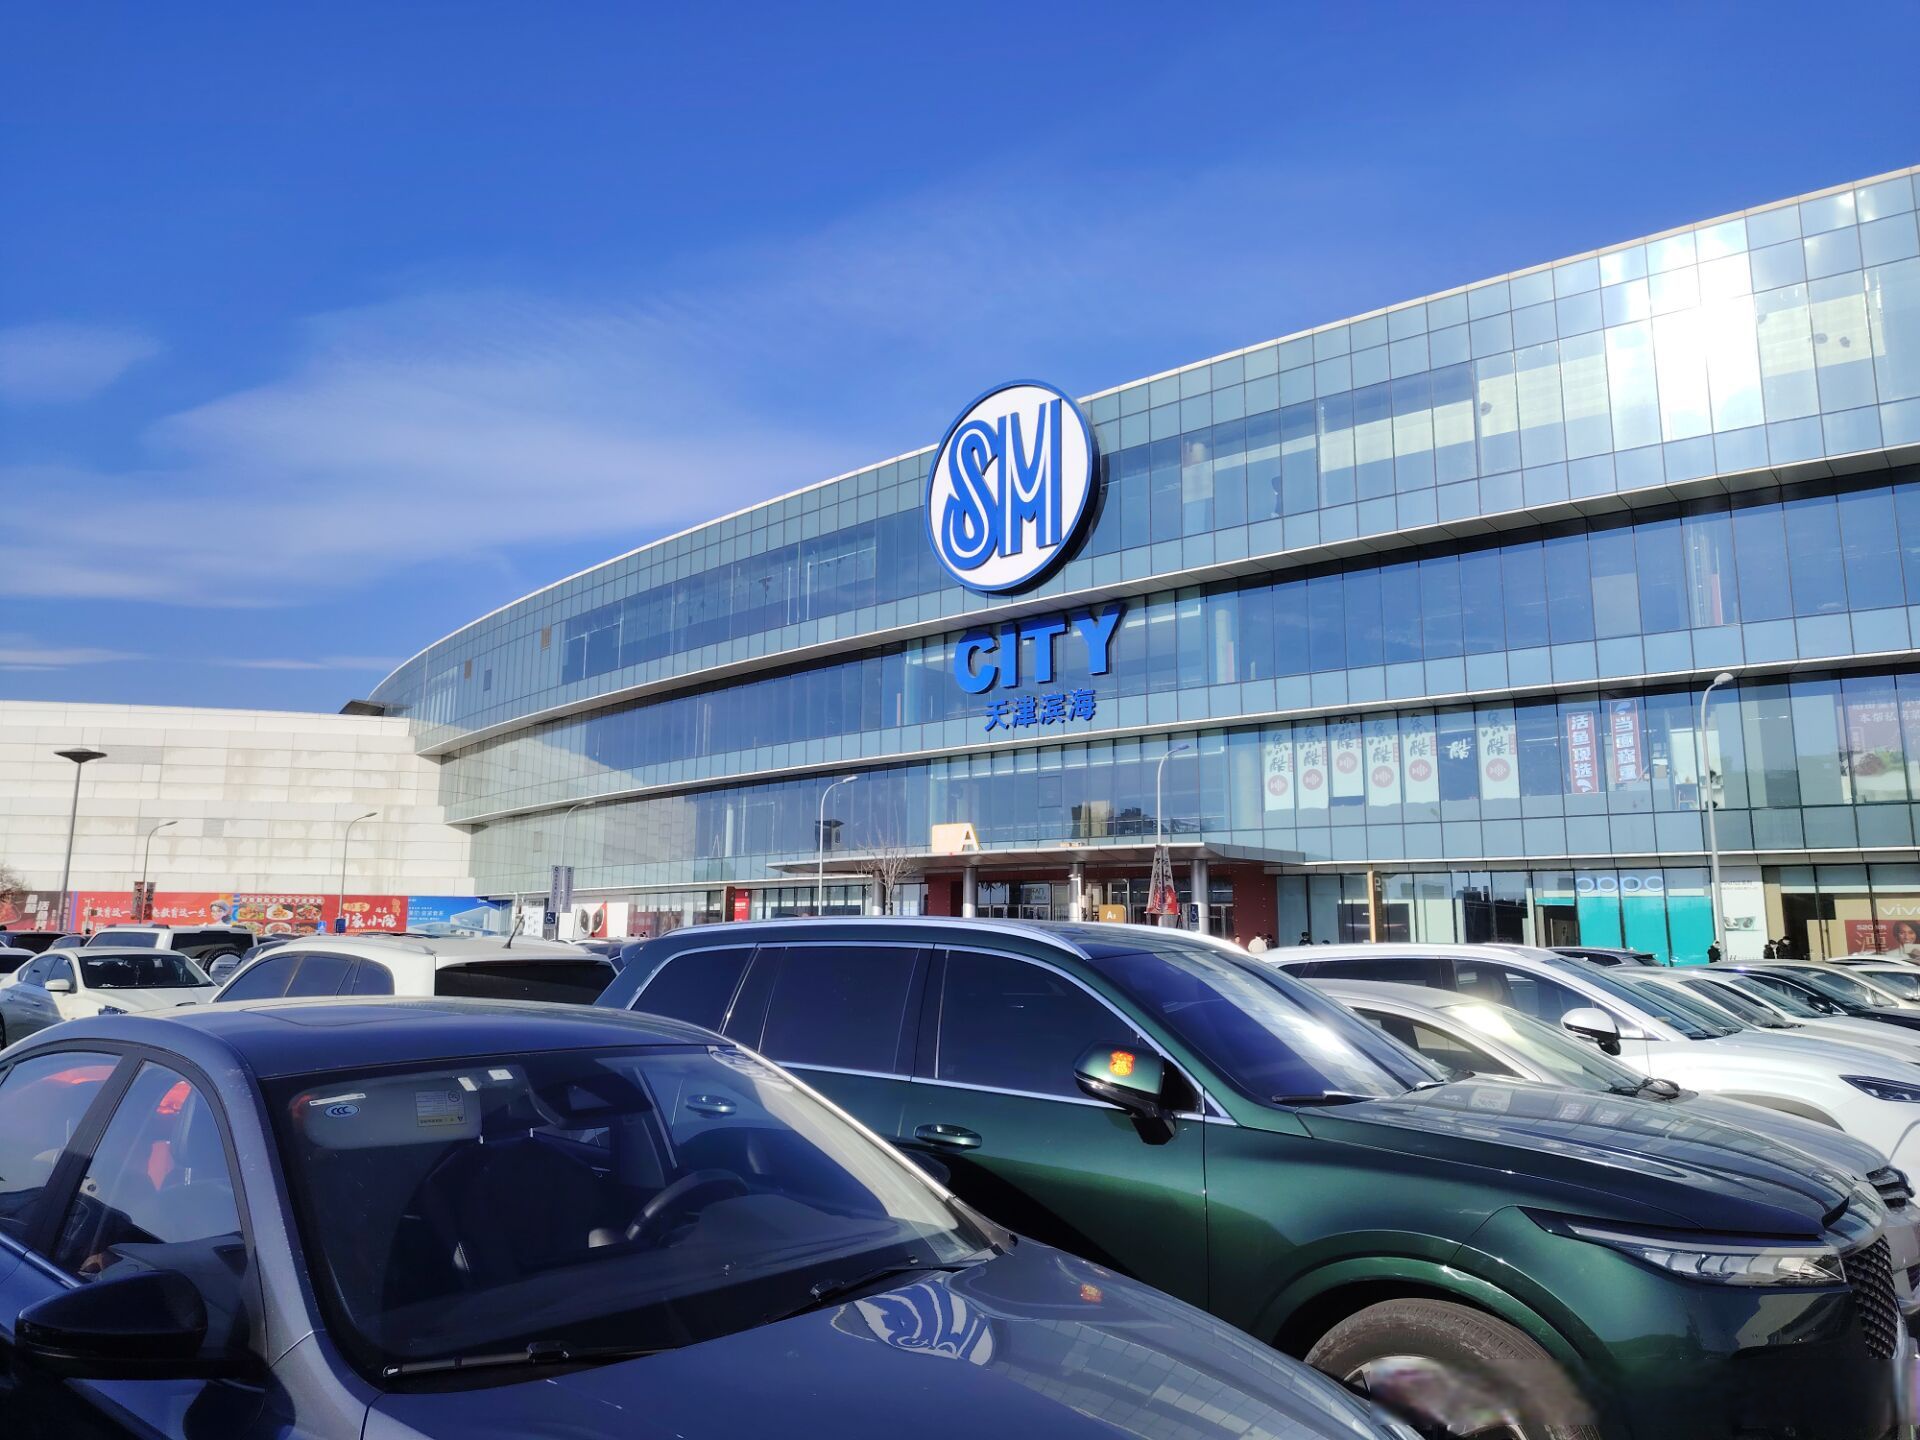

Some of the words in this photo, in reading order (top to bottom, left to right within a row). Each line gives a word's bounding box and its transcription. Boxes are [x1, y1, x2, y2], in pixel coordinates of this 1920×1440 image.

[941, 398, 1062, 571] SM
[954, 602, 1128, 694] CITY
[983, 688, 1097, 732] 天津滨海
[960, 822, 979, 852] A
